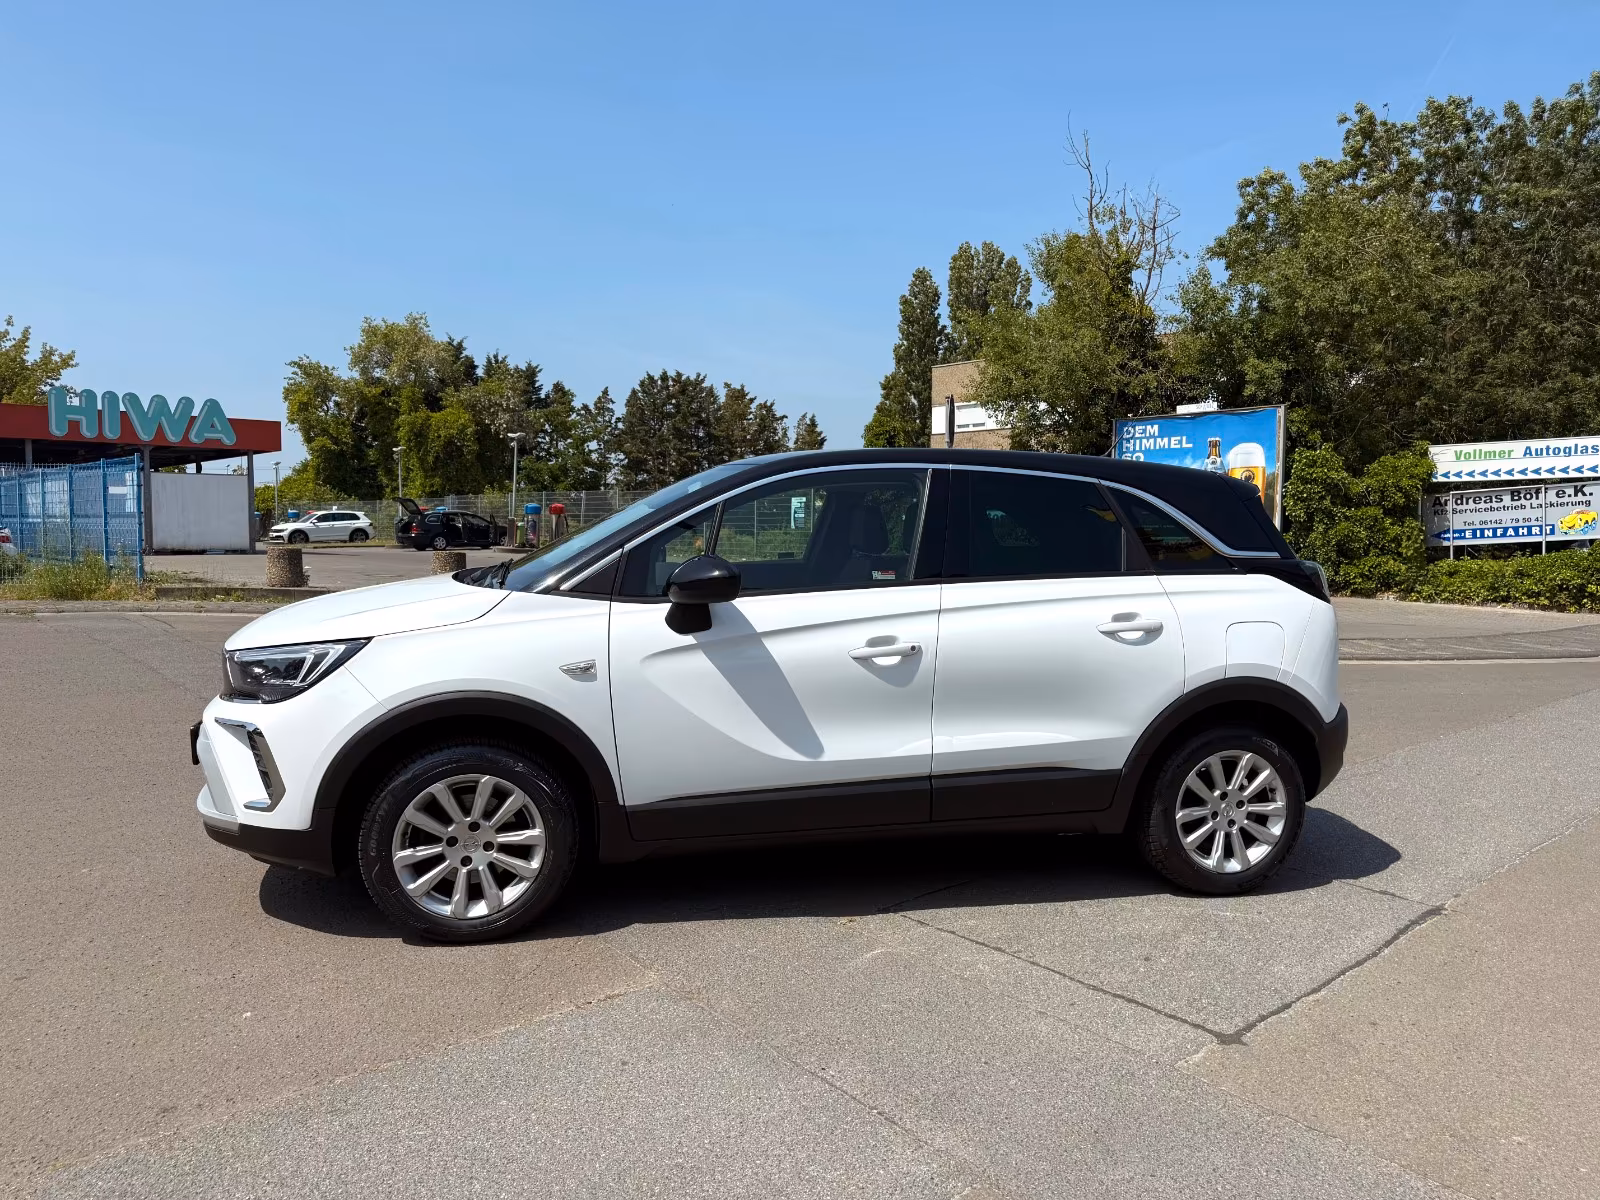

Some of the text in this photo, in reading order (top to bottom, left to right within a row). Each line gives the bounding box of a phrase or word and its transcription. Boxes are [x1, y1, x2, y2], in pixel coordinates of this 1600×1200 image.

[48, 386, 237, 446] HIWA
[1123, 424, 1159, 438] DEM
[1122, 436, 1193, 452] HIMMEL
[1454, 443, 1600, 461] Vollmer Autoglas
[1432, 493, 1504, 508] Andreas
[1555, 484, 1594, 499] e.K.
[1479, 518, 1503, 526] 06142
[1465, 525, 1553, 539] EINFAHRT
